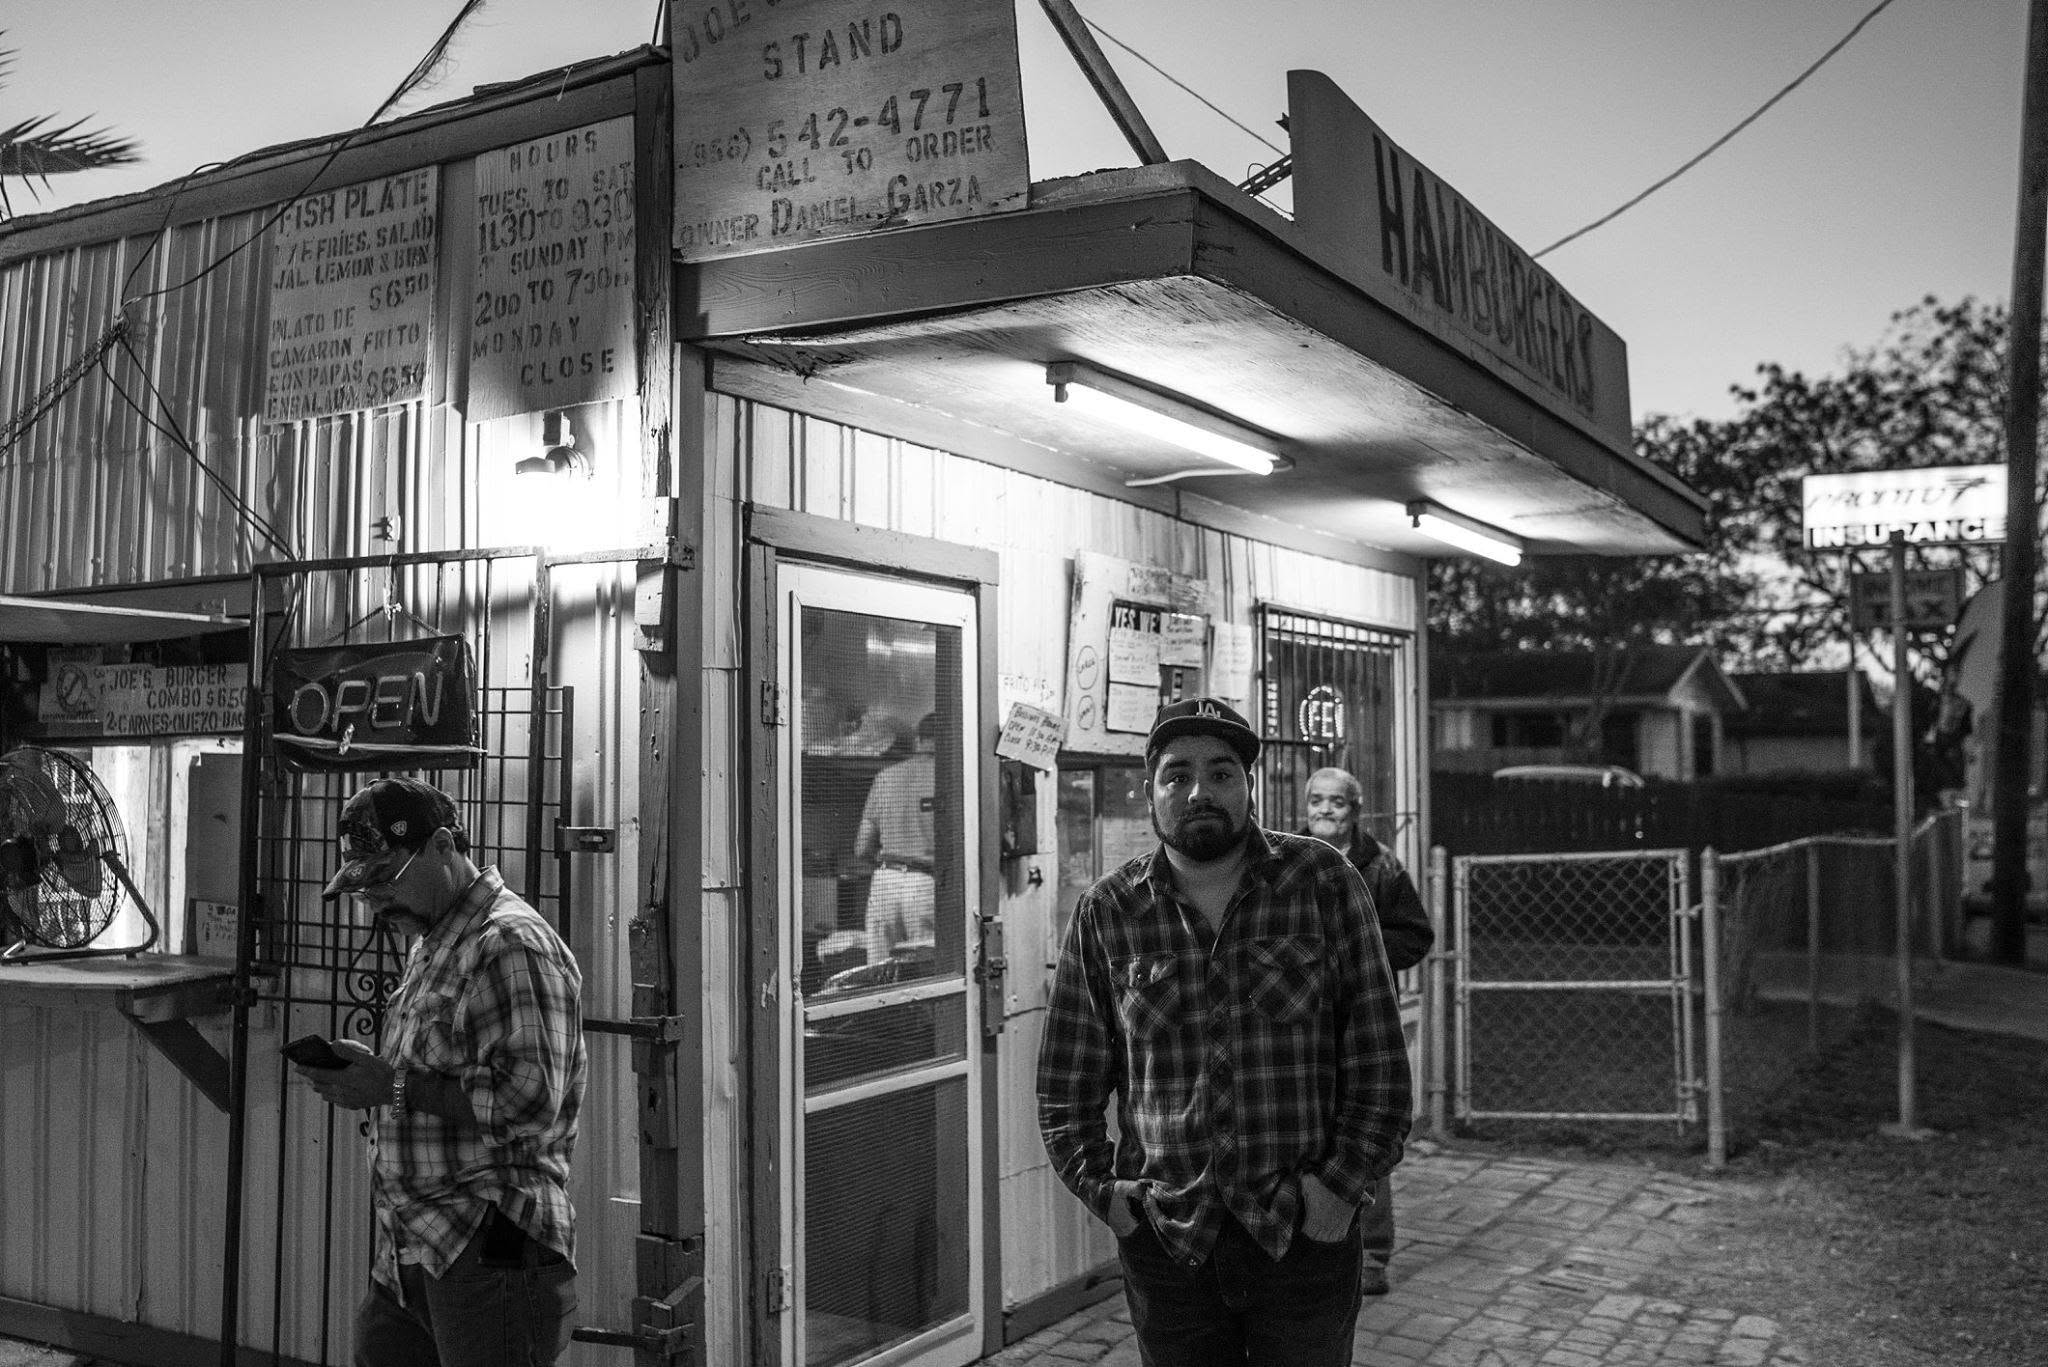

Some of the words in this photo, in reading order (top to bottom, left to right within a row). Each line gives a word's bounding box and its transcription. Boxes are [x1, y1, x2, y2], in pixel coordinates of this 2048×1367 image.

[763, 13, 903, 80] STAND
[768, 77, 990, 158] 542-4771
[510, 130, 597, 172] HOURS
[757, 157, 816, 192] CALL
[841, 147, 873, 175] TO
[906, 124, 994, 162] ORDER
[279, 193, 336, 234] FISH
[345, 171, 429, 219] PLATE
[544, 177, 569, 200] TO
[887, 174, 983, 214] GARZA
[315, 256, 374, 285] LEMON
[511, 236, 588, 275] SUNDAY
[1373, 131, 1594, 413] HAMBURGERS
[527, 278, 554, 304] TO
[363, 322, 420, 353] FRITO
[473, 316, 580, 361] MONDAY
[520, 348, 615, 386] CLOSE
[166, 666, 227, 690] BURGER
[147, 686, 201, 711] COMBO
[292, 672, 441, 735] OPEN
